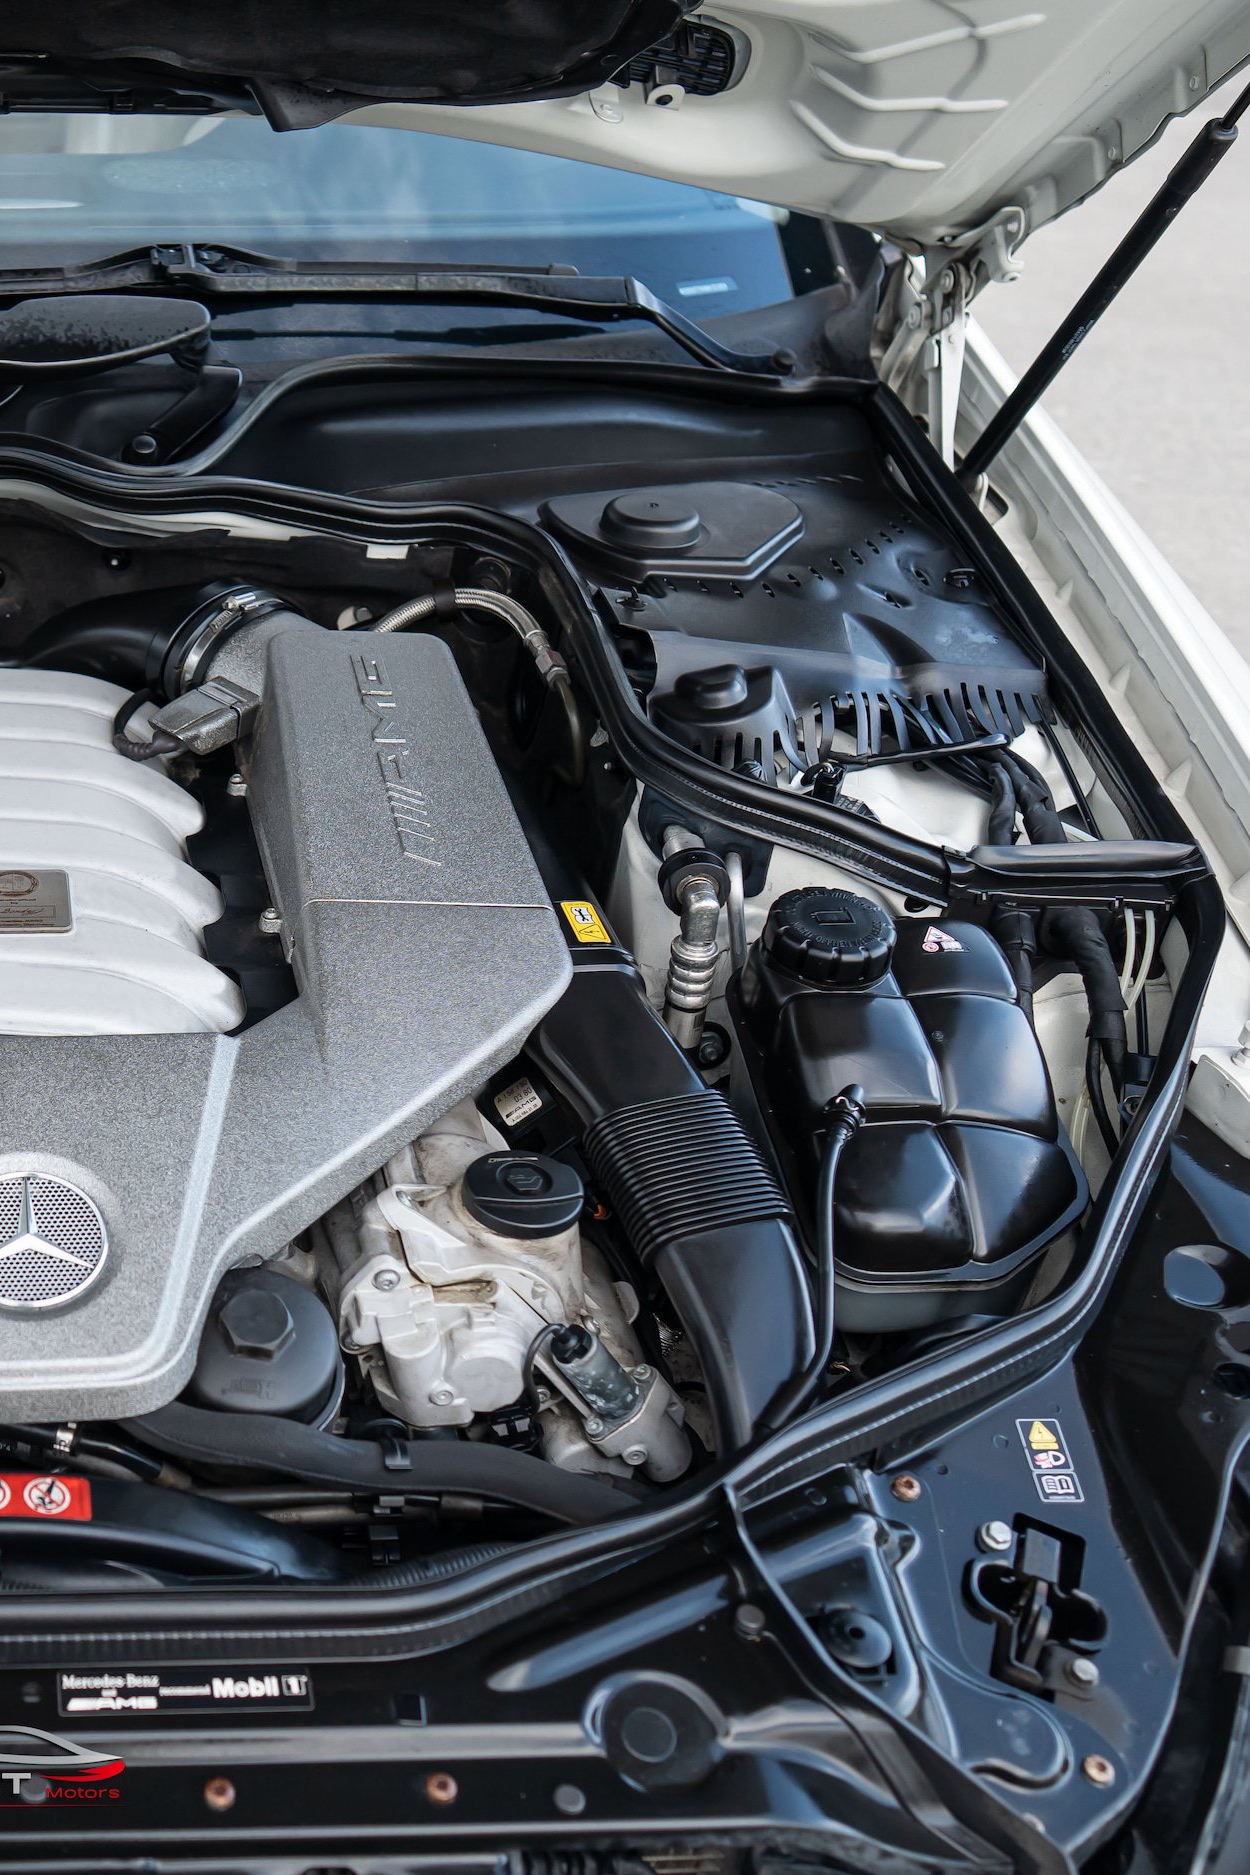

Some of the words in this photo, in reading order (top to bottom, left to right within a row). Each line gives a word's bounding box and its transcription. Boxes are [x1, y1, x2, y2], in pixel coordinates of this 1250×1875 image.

[62, 1673, 160, 1689] Mercedes-Benz
[212, 1675, 280, 1699] Mobil
[94, 1696, 158, 1711] AMG
